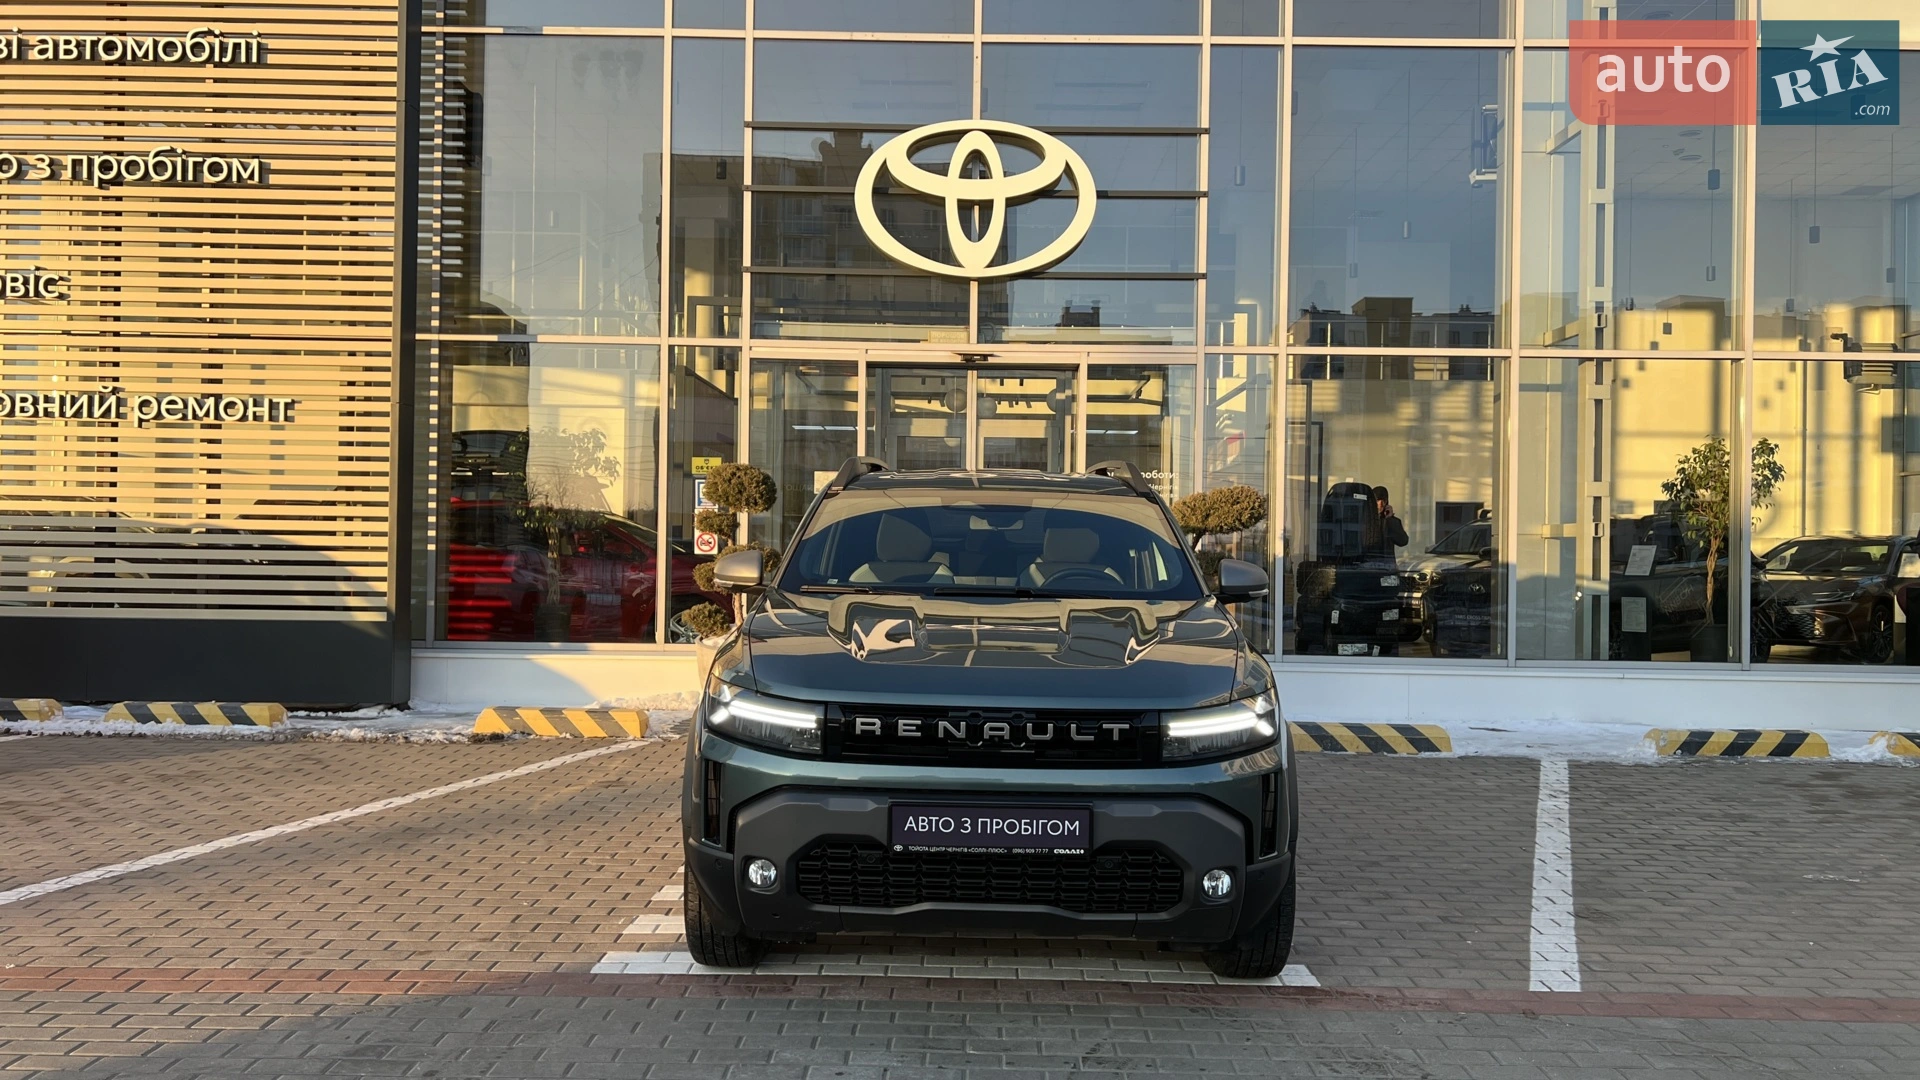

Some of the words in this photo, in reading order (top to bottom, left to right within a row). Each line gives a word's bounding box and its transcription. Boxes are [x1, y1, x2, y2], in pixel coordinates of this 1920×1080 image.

[33, 26, 259, 63] автомобілі
[32, 154, 51, 180] з
[67, 145, 260, 188] пробігом
[0, 265, 60, 298] віс
[134, 394, 292, 428] ремонт
[855, 717, 1130, 741] RENAULT
[904, 815, 955, 833] АВТО
[960, 817, 972, 834] З
[977, 818, 1080, 836] ПРОБІГОМ
